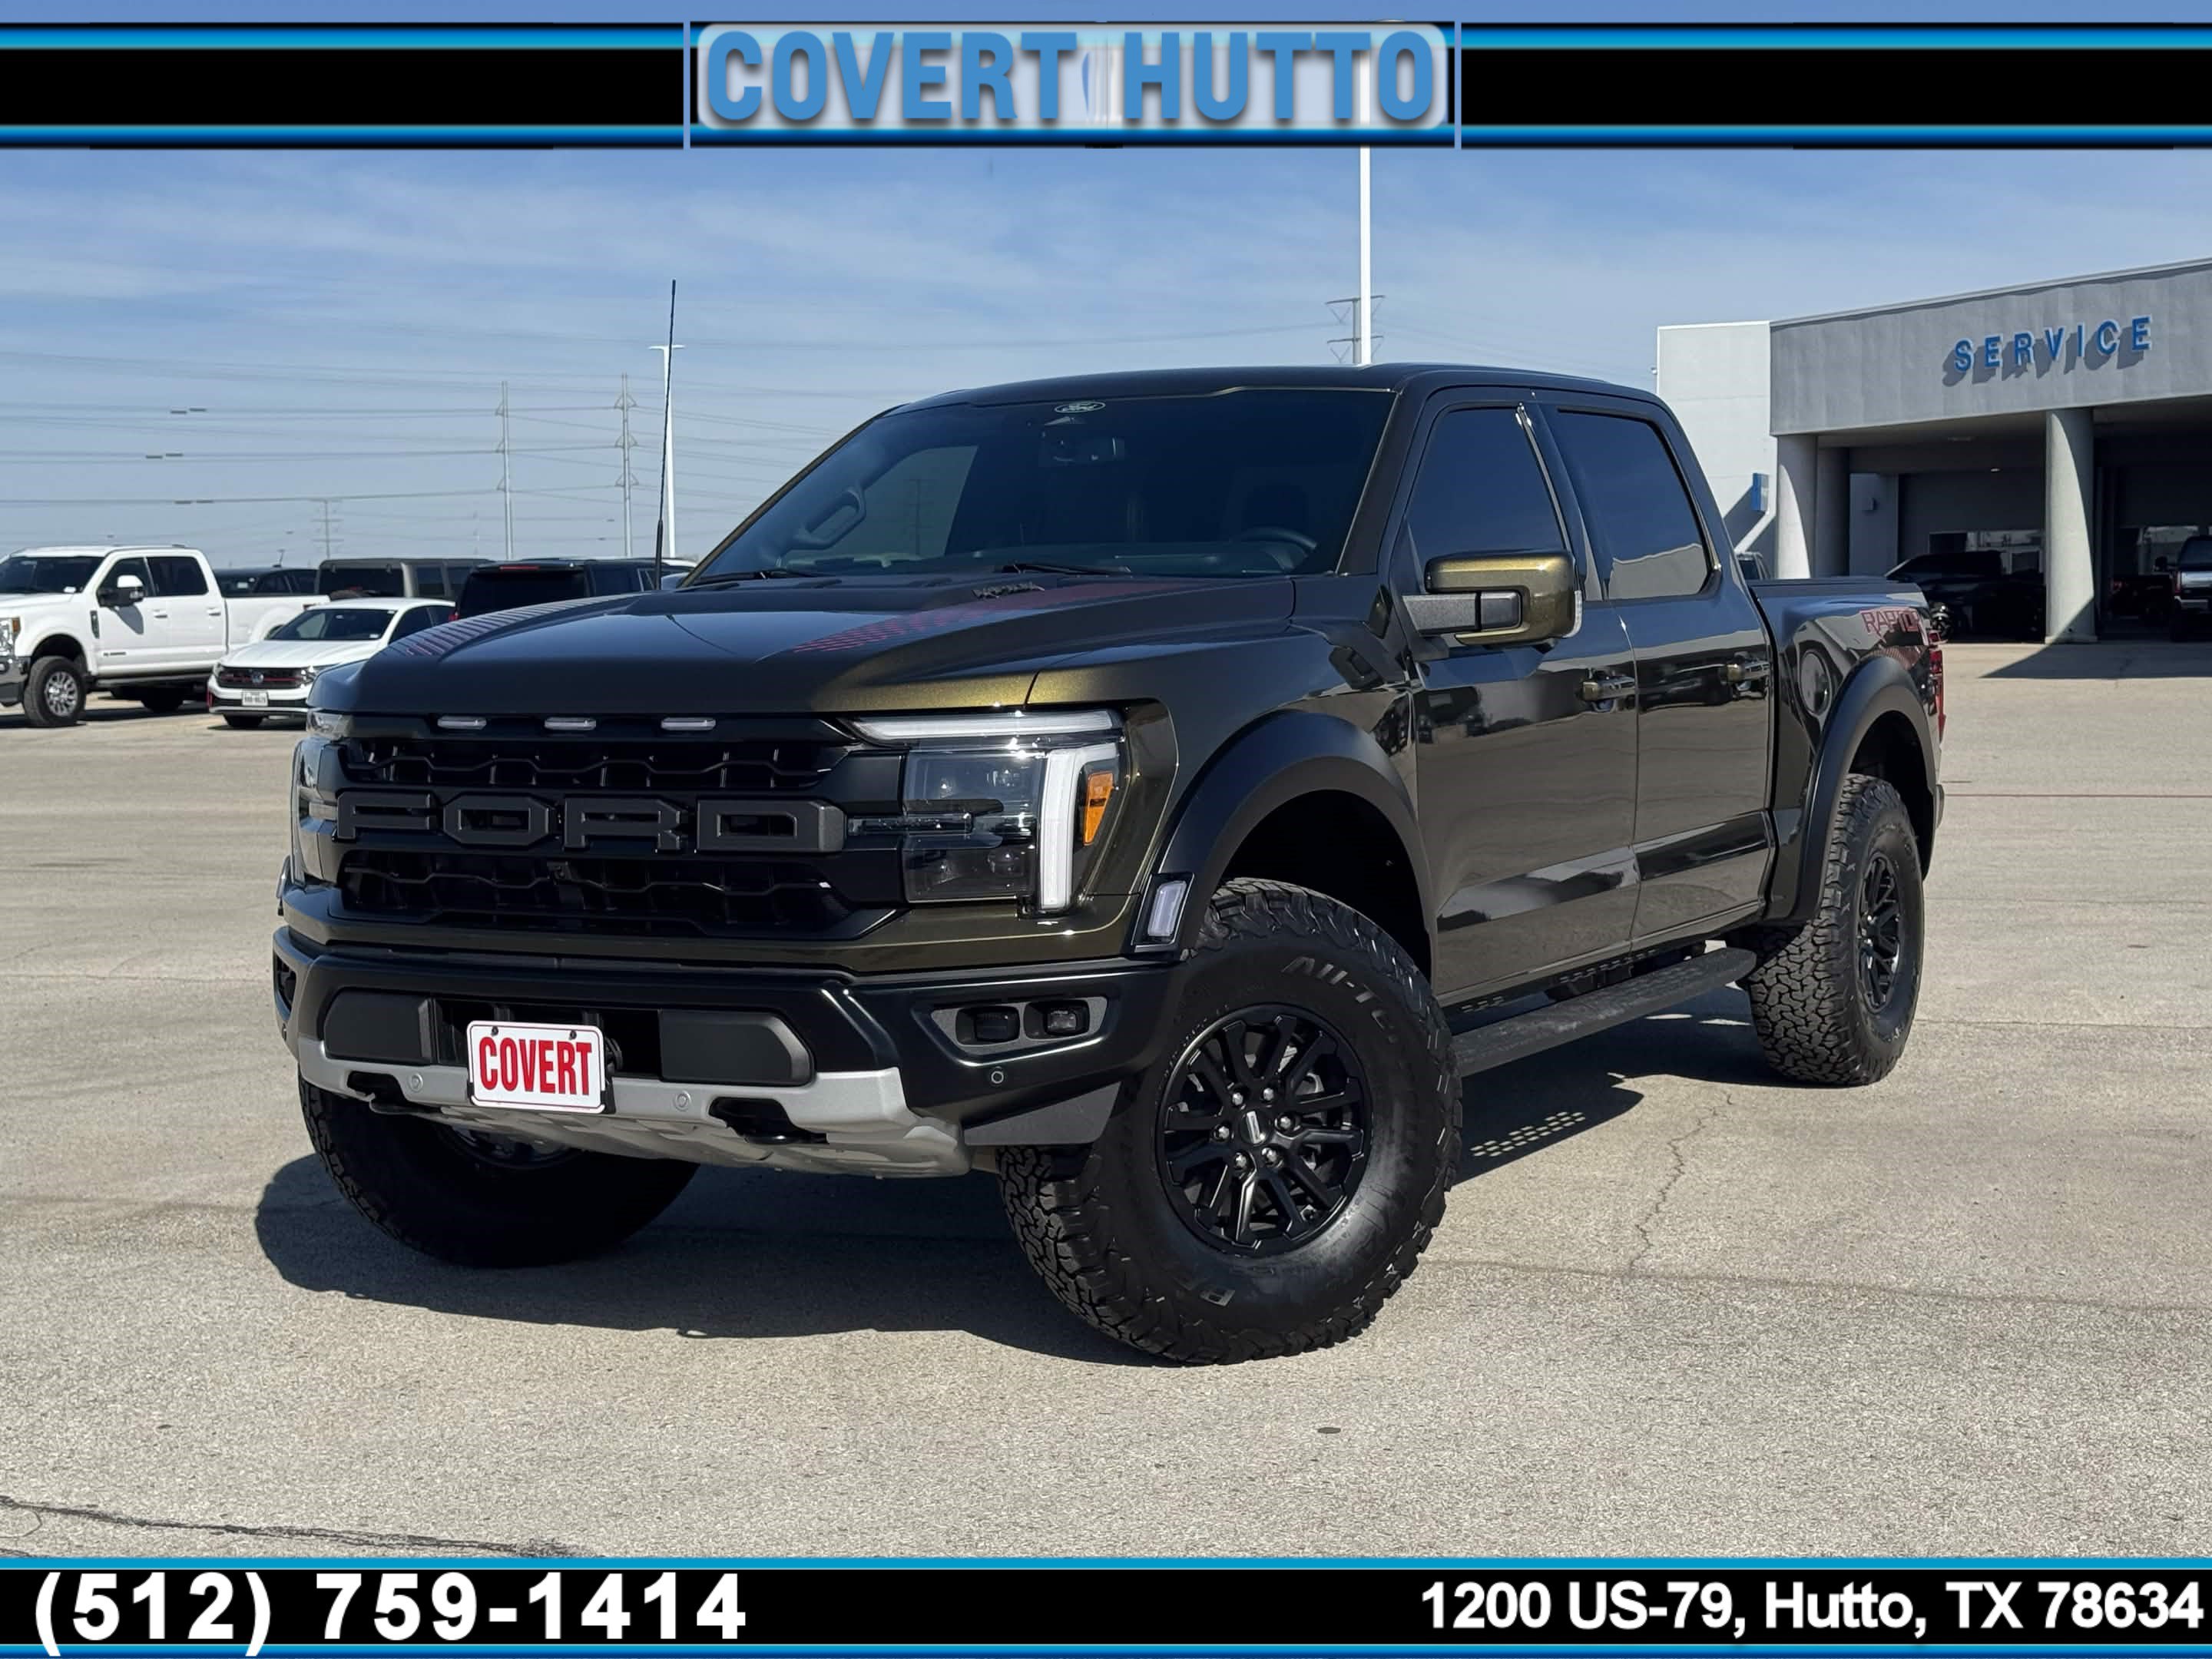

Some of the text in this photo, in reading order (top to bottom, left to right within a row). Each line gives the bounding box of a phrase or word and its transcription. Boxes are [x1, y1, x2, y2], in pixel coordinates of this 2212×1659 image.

[1954, 316, 2152, 373] SERVICE
[336, 791, 846, 854] FORD
[478, 1036, 594, 1096] COVERT
